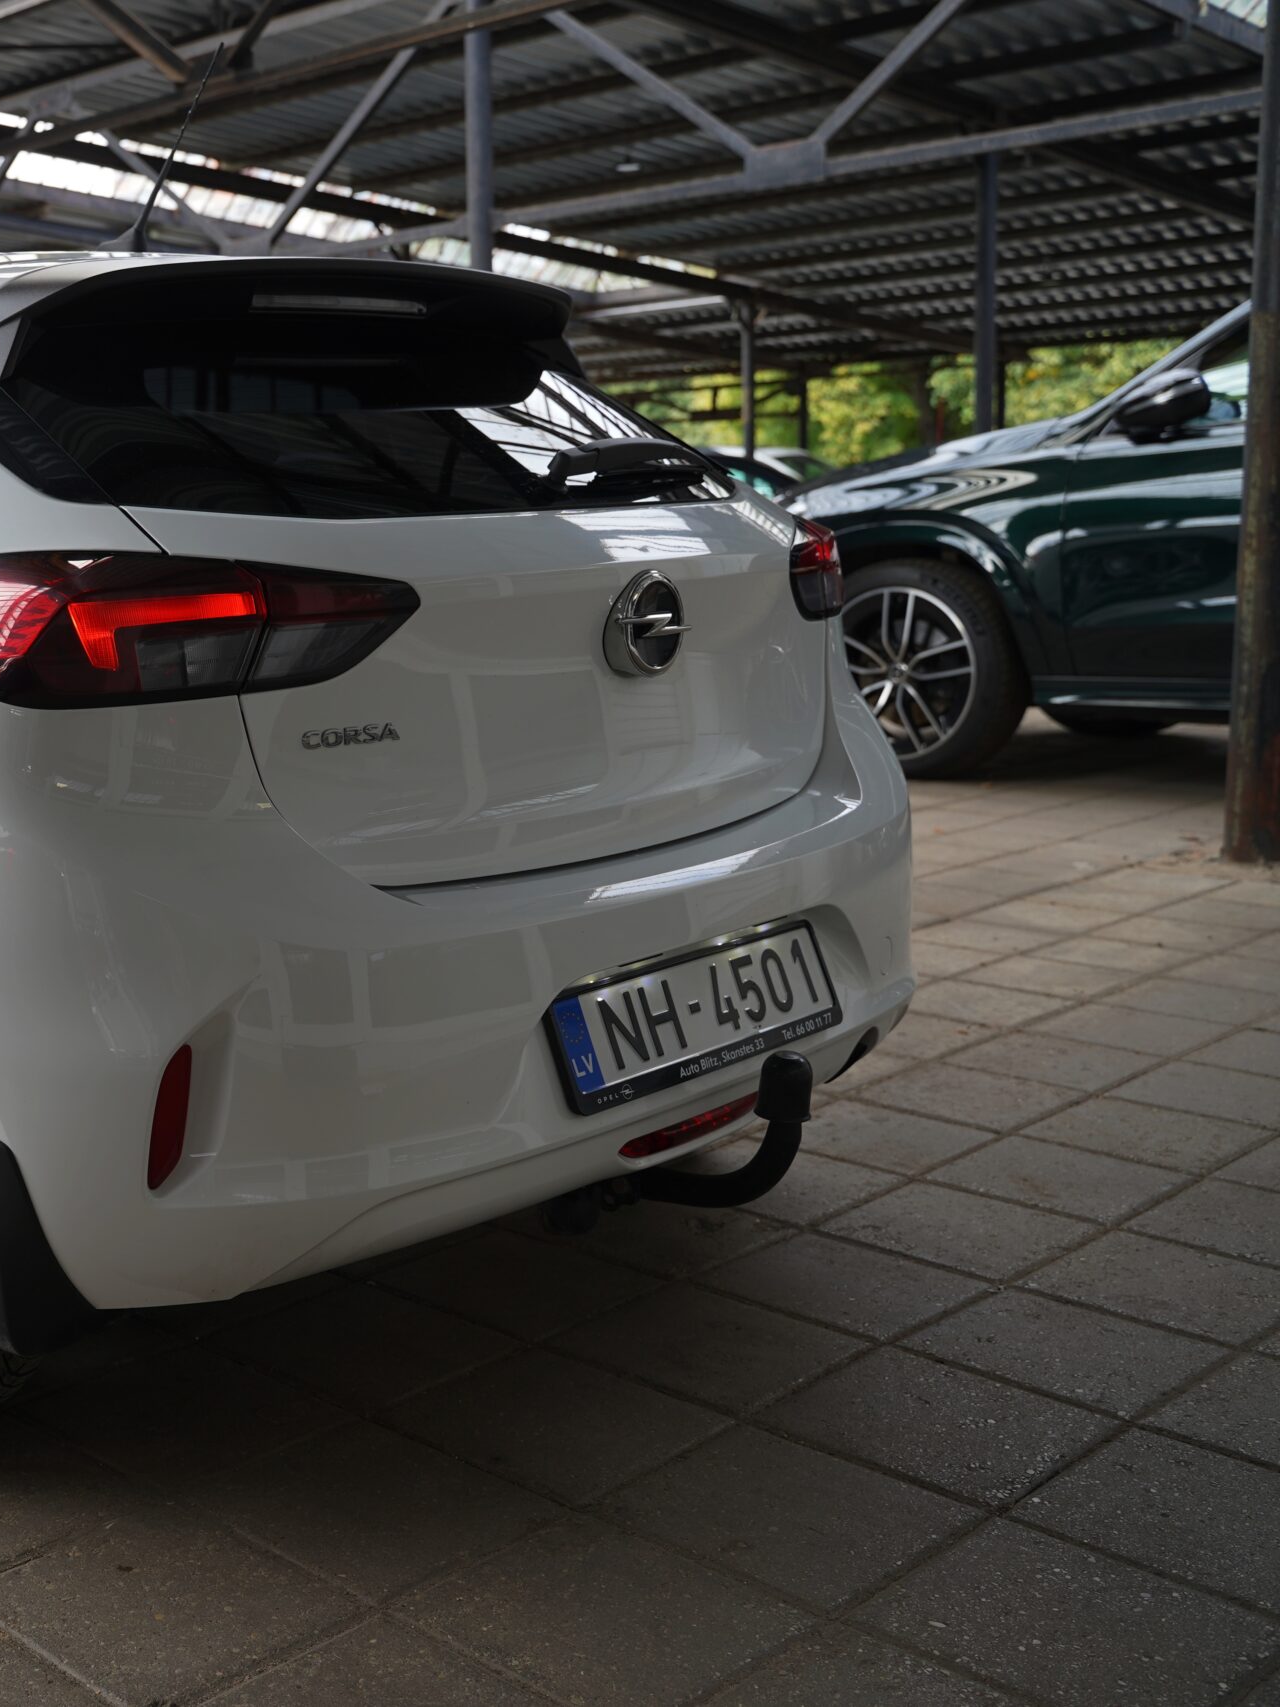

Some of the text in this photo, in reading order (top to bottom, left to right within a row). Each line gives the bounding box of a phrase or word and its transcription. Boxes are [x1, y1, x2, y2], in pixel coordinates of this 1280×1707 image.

[301, 722, 401, 750] CORSA
[596, 938, 819, 1070] NH-4501
[679, 1062, 700, 1078] Auto
[754, 1038, 765, 1050] 33
[781, 1027, 796, 1041] Tel.
[795, 1024, 805, 1036] 66
[805, 1020, 815, 1032] 00
[815, 1016, 823, 1027] 11
[822, 1012, 832, 1024] 77
[571, 1053, 594, 1077] LV
[597, 1093, 620, 1104] OPEL
